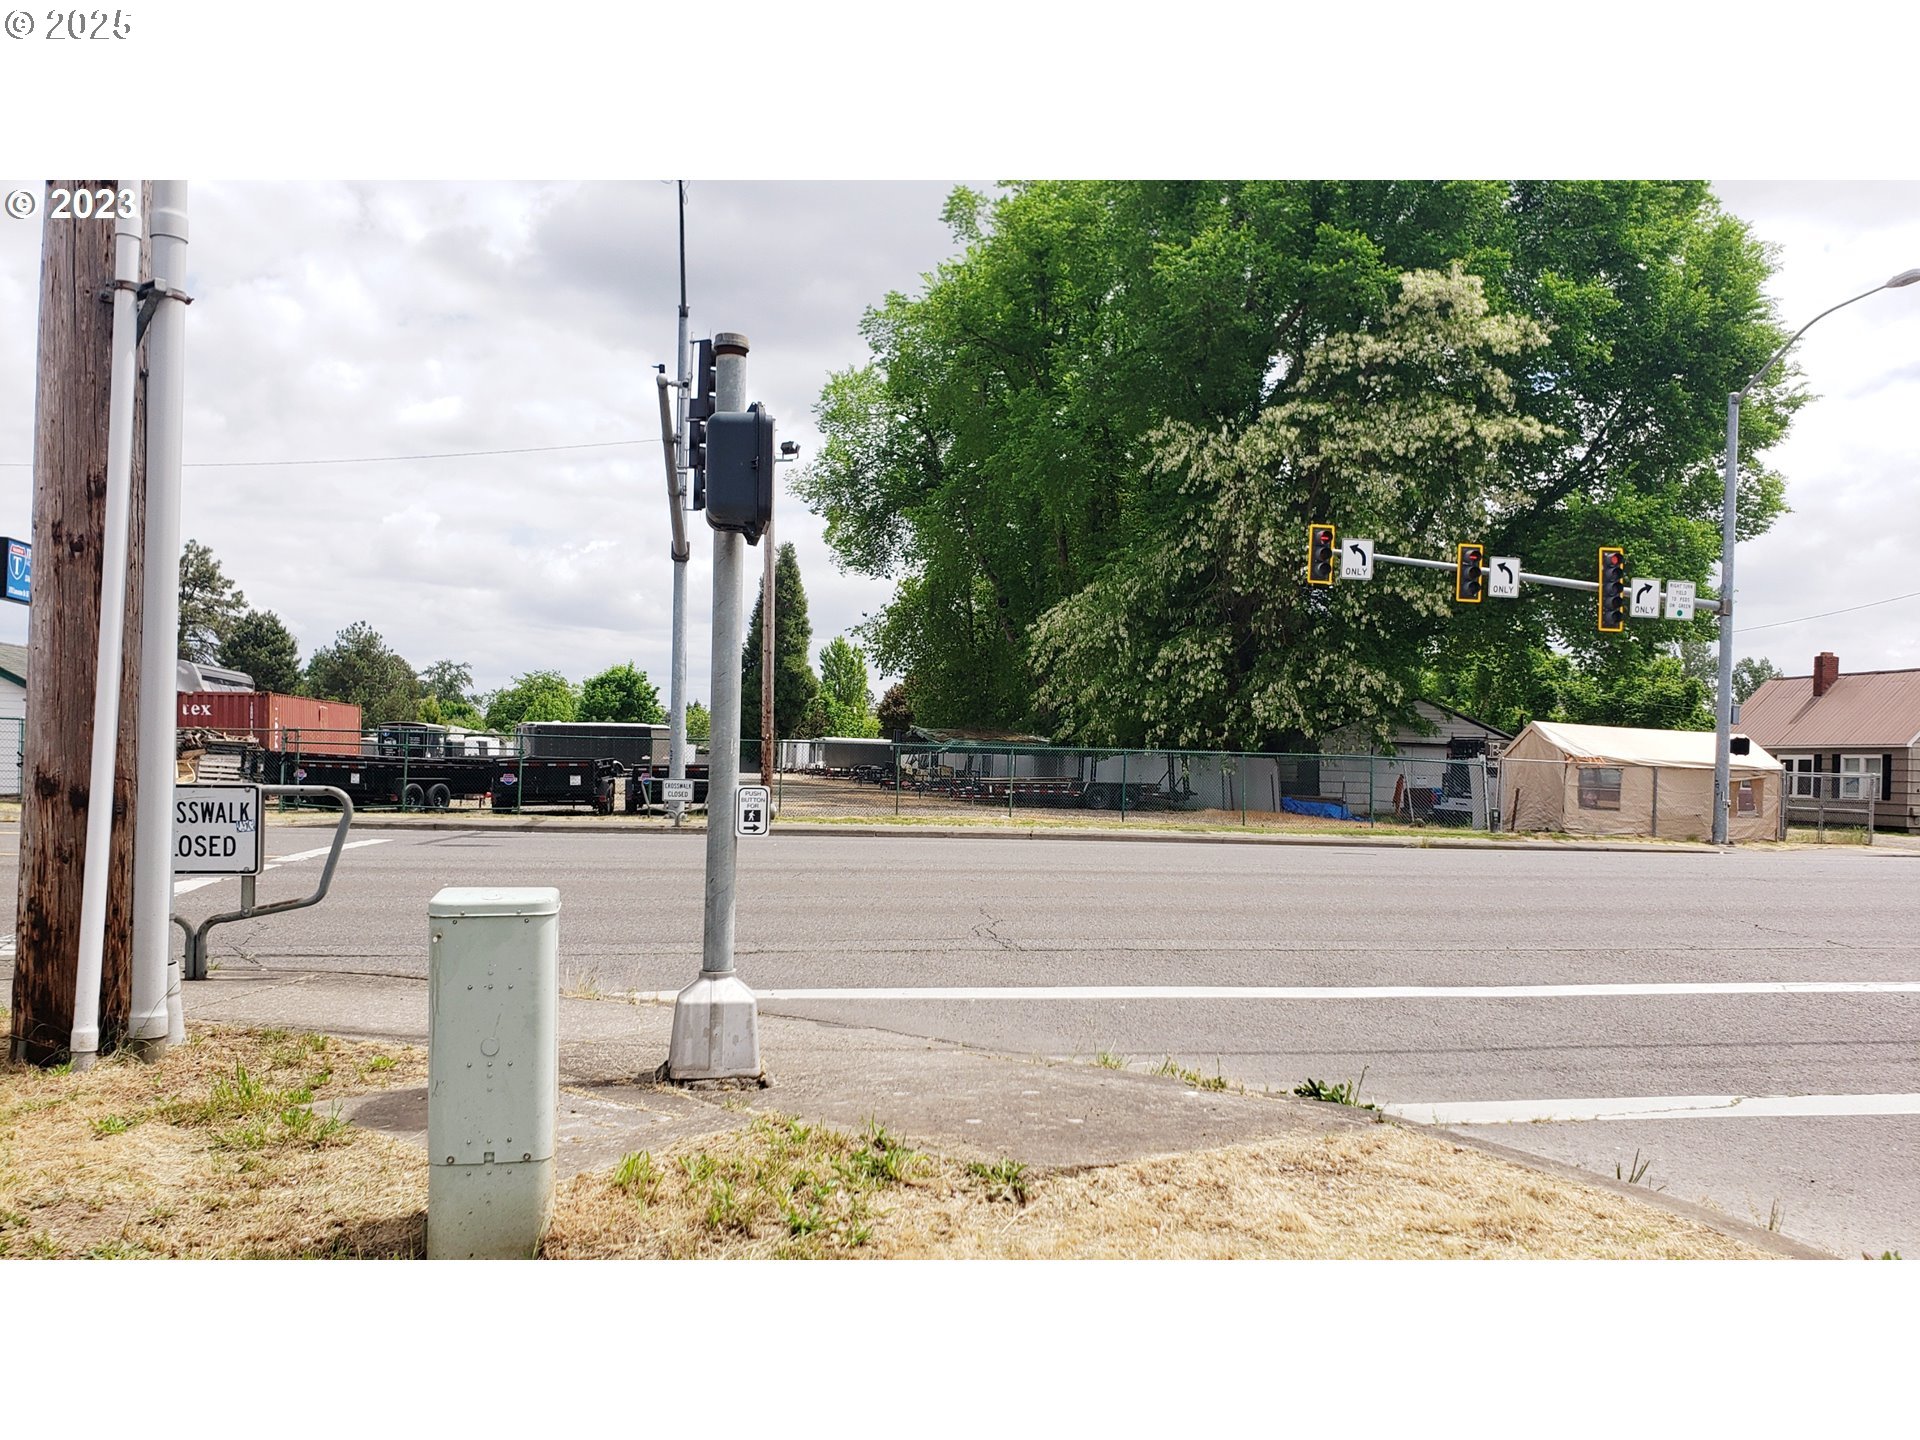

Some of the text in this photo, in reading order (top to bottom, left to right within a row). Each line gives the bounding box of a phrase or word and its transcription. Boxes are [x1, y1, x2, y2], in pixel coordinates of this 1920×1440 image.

[1345, 567, 1367, 576] ONLY
[1493, 585, 1514, 594] ONLY
[1635, 605, 1655, 614] ONLY
[182, 703, 212, 716] tex
[665, 782, 692, 790] CROSSWALK
[668, 790, 688, 798] CLOSED
[176, 801, 250, 824] SSWALK
[175, 834, 236, 857] OSED
